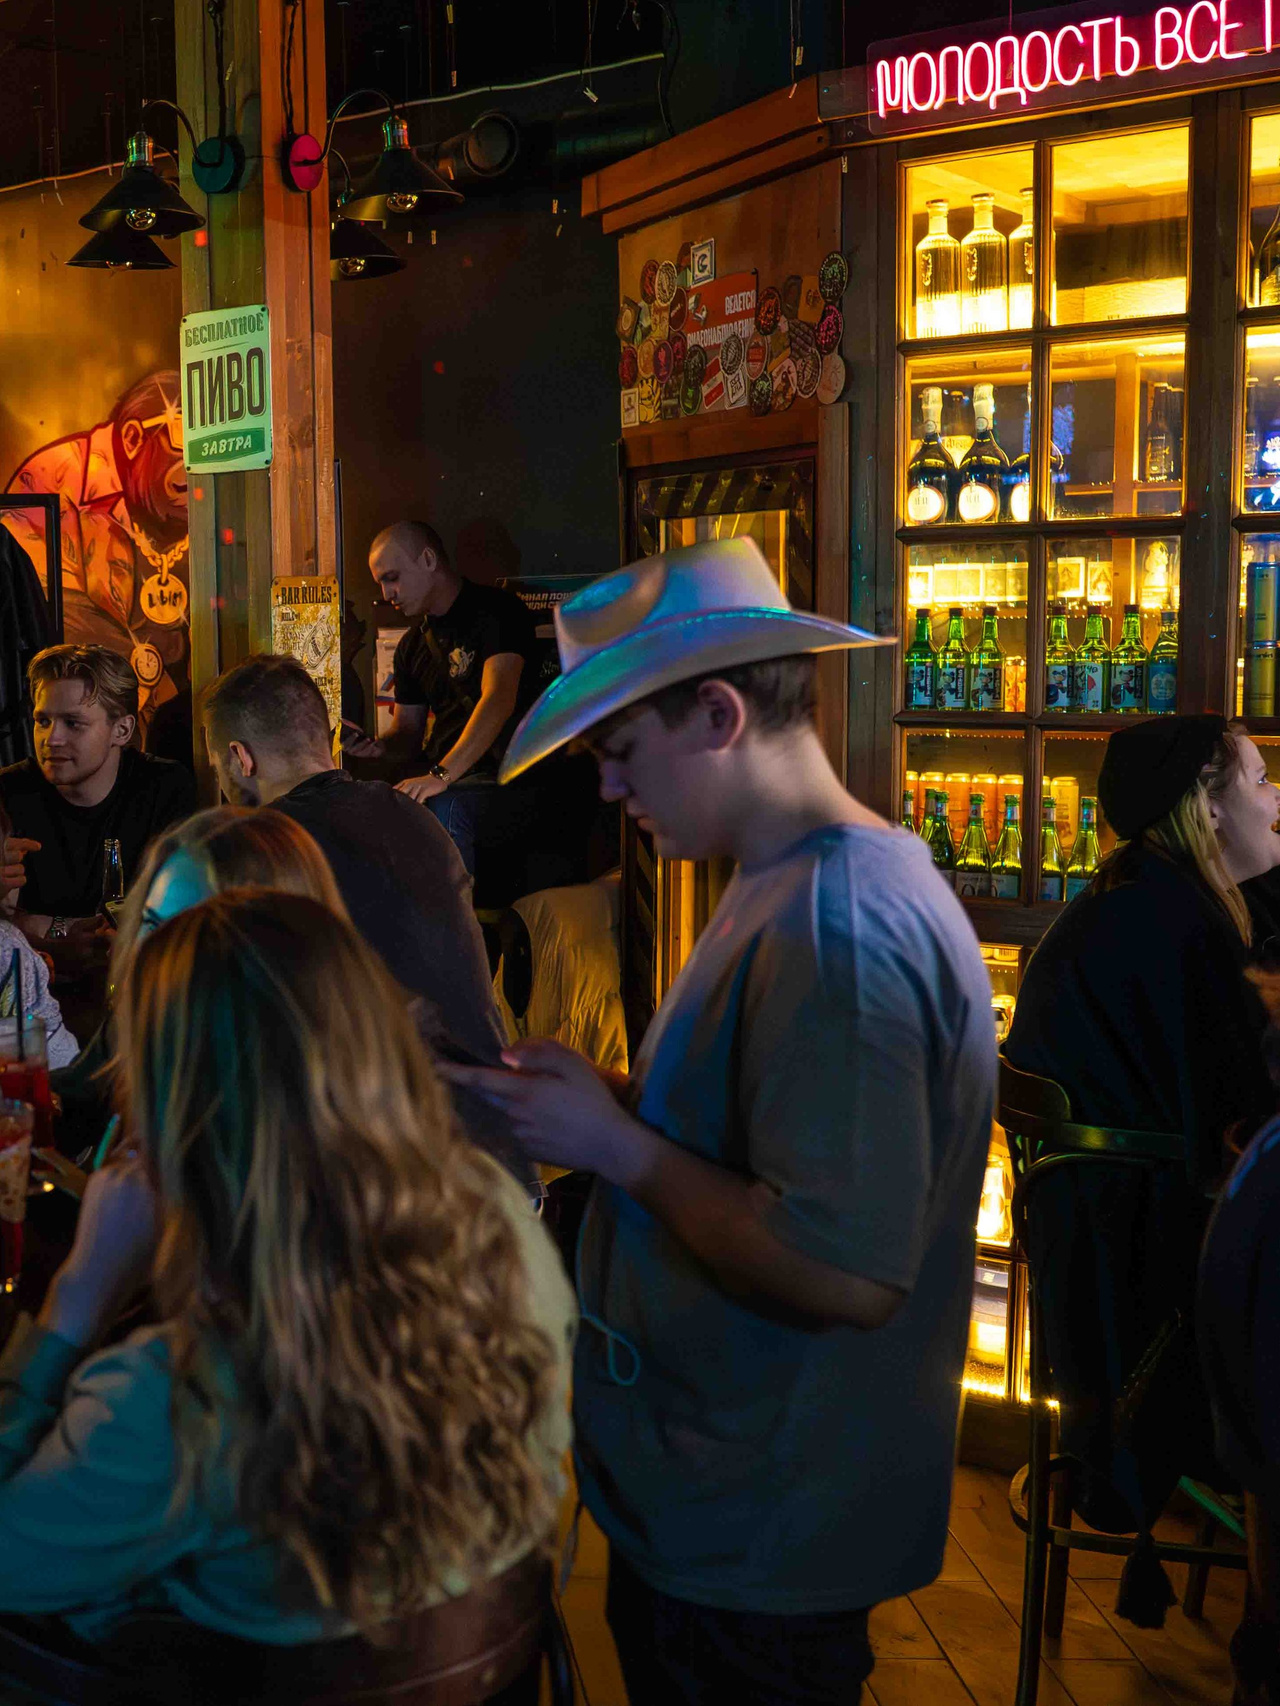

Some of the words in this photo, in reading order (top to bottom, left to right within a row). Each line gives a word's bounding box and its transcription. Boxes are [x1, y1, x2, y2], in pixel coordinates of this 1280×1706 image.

[876, 15, 1141, 119] МОЛОДОСТЬ
[1154, 0, 1249, 71] ВСЕ
[185, 312, 265, 348] БЕСПЛАТНОЕ
[186, 347, 266, 430] ПИВО
[201, 434, 252, 456] ЗАВТРА
[281, 587, 300, 605] BAR
[301, 586, 332, 604] RULES
